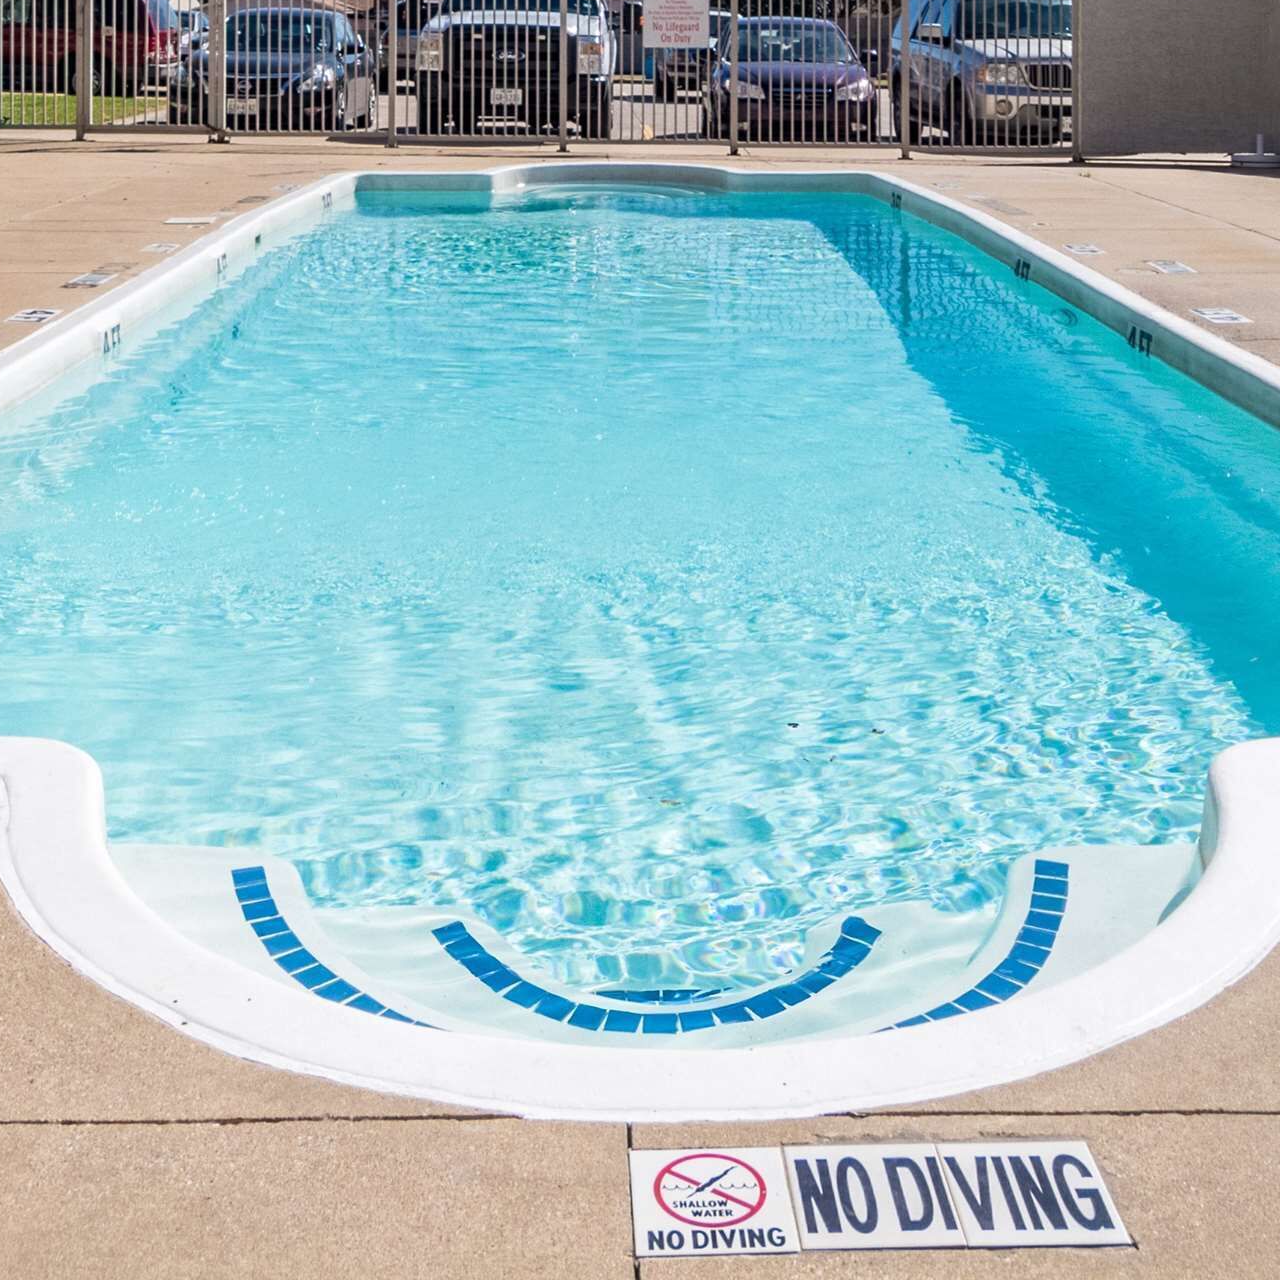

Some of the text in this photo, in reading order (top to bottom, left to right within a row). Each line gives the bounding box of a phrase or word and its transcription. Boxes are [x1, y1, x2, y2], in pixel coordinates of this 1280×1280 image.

[652, 21, 700, 33] No Lifeguard
[660, 33, 691, 43] On Duty
[794, 1153, 1116, 1234] NO DIVING
[672, 1200, 729, 1208] SHALLOW
[691, 1208, 734, 1218] WATER
[647, 1226, 786, 1251] NO DIVING
